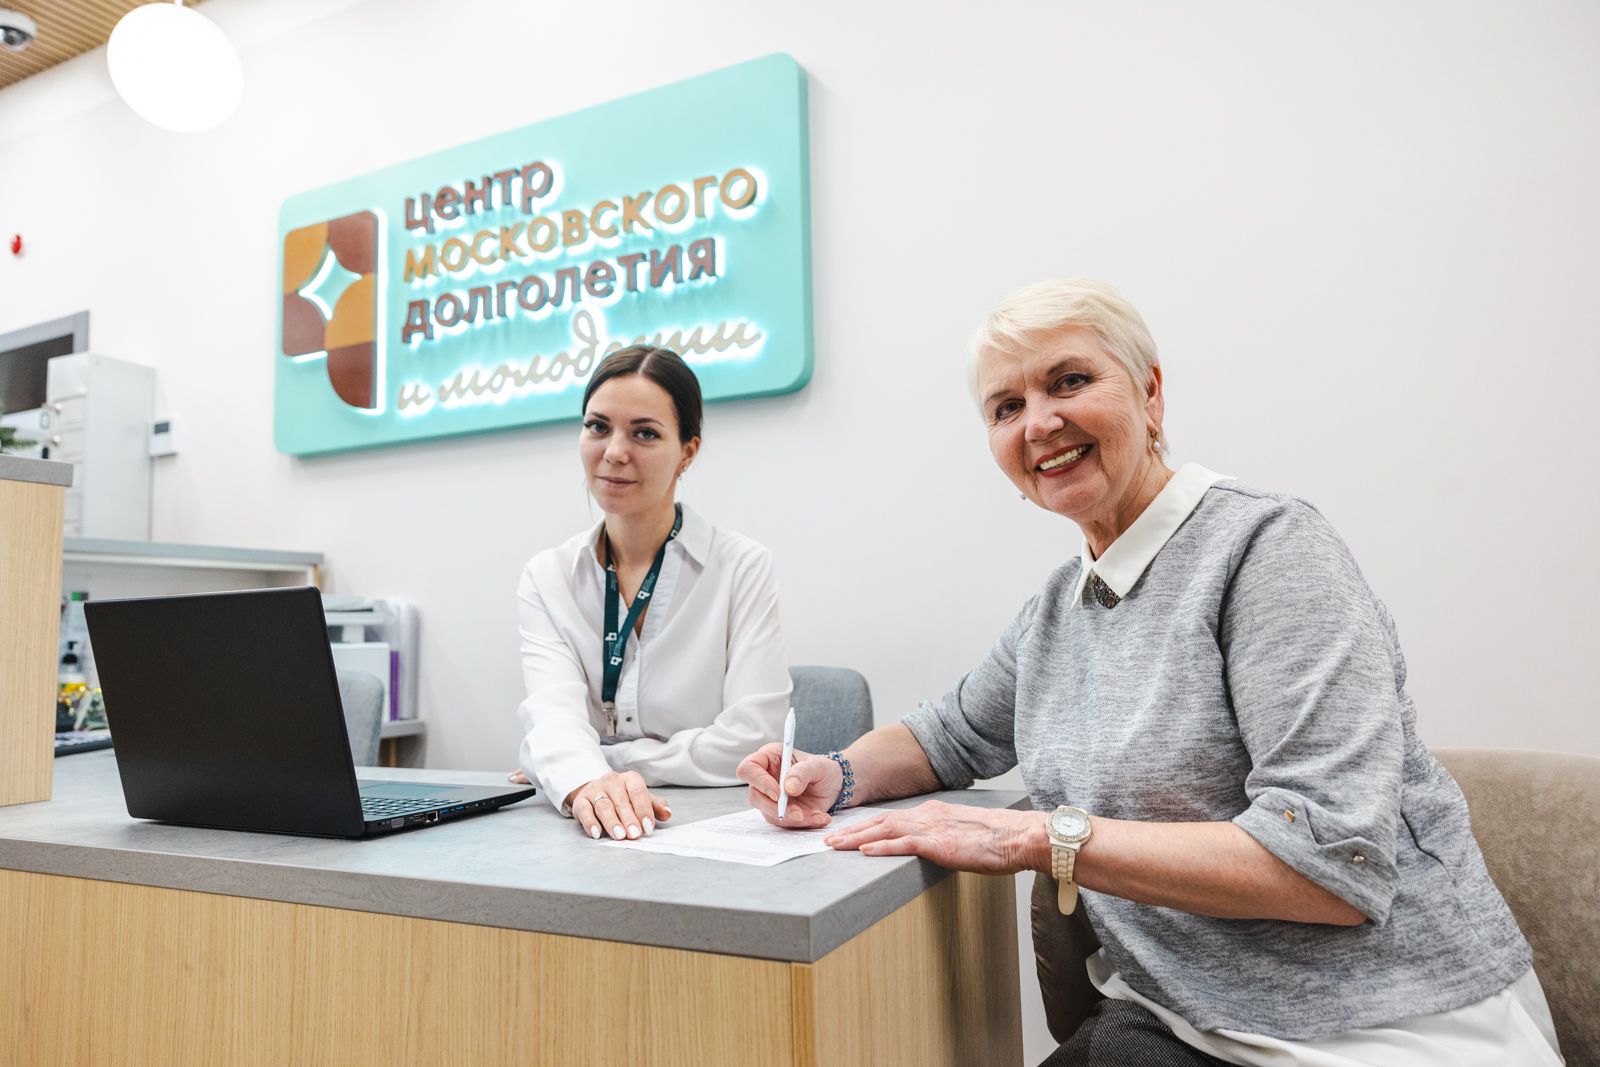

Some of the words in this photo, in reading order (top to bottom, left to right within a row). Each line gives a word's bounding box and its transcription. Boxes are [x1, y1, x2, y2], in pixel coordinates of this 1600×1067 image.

[403, 168, 758, 283] московского
[405, 161, 554, 234] центр
[402, 237, 716, 343] долголетия
[397, 384, 430, 410] и
[439, 309, 762, 402] молодти
